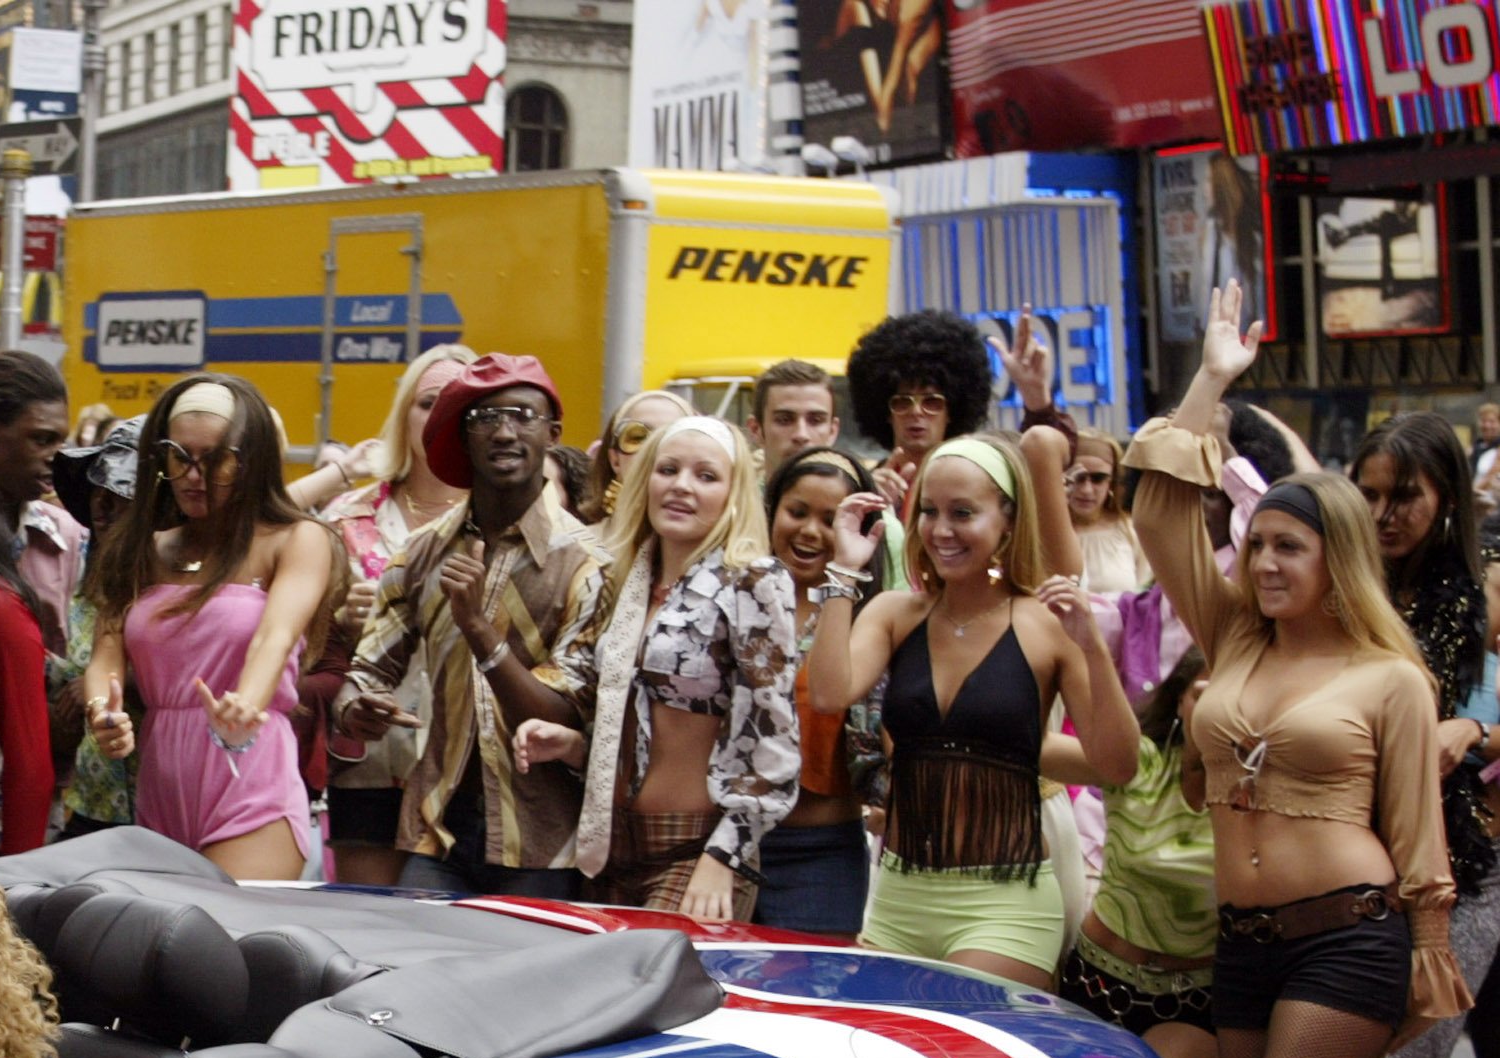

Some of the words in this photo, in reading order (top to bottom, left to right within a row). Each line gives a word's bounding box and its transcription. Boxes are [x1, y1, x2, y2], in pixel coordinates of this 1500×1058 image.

[666, 245, 871, 290] PENSKE
[350, 300, 394, 322] Local
[104, 318, 199, 346] PENSKE
[337, 336, 368, 359] One
[369, 336, 402, 363] Way
